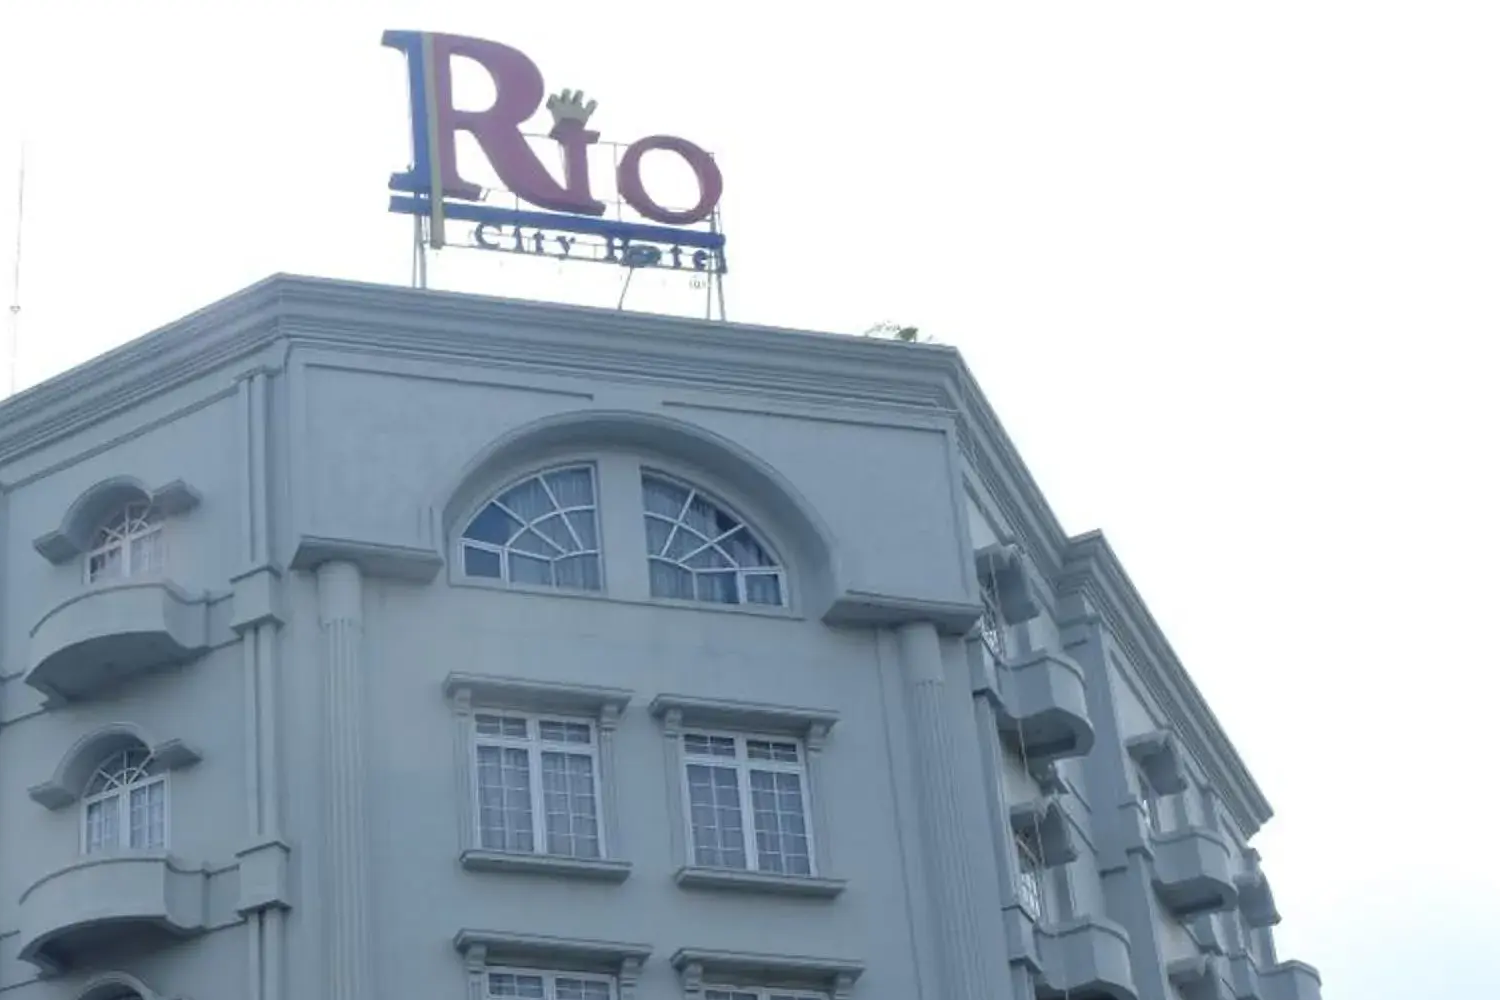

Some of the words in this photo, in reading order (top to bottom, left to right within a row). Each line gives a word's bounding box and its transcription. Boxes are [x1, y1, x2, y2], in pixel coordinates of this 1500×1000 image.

[381, 29, 723, 225] Rio
[474, 222, 576, 260] City
[605, 235, 727, 274] Htel
